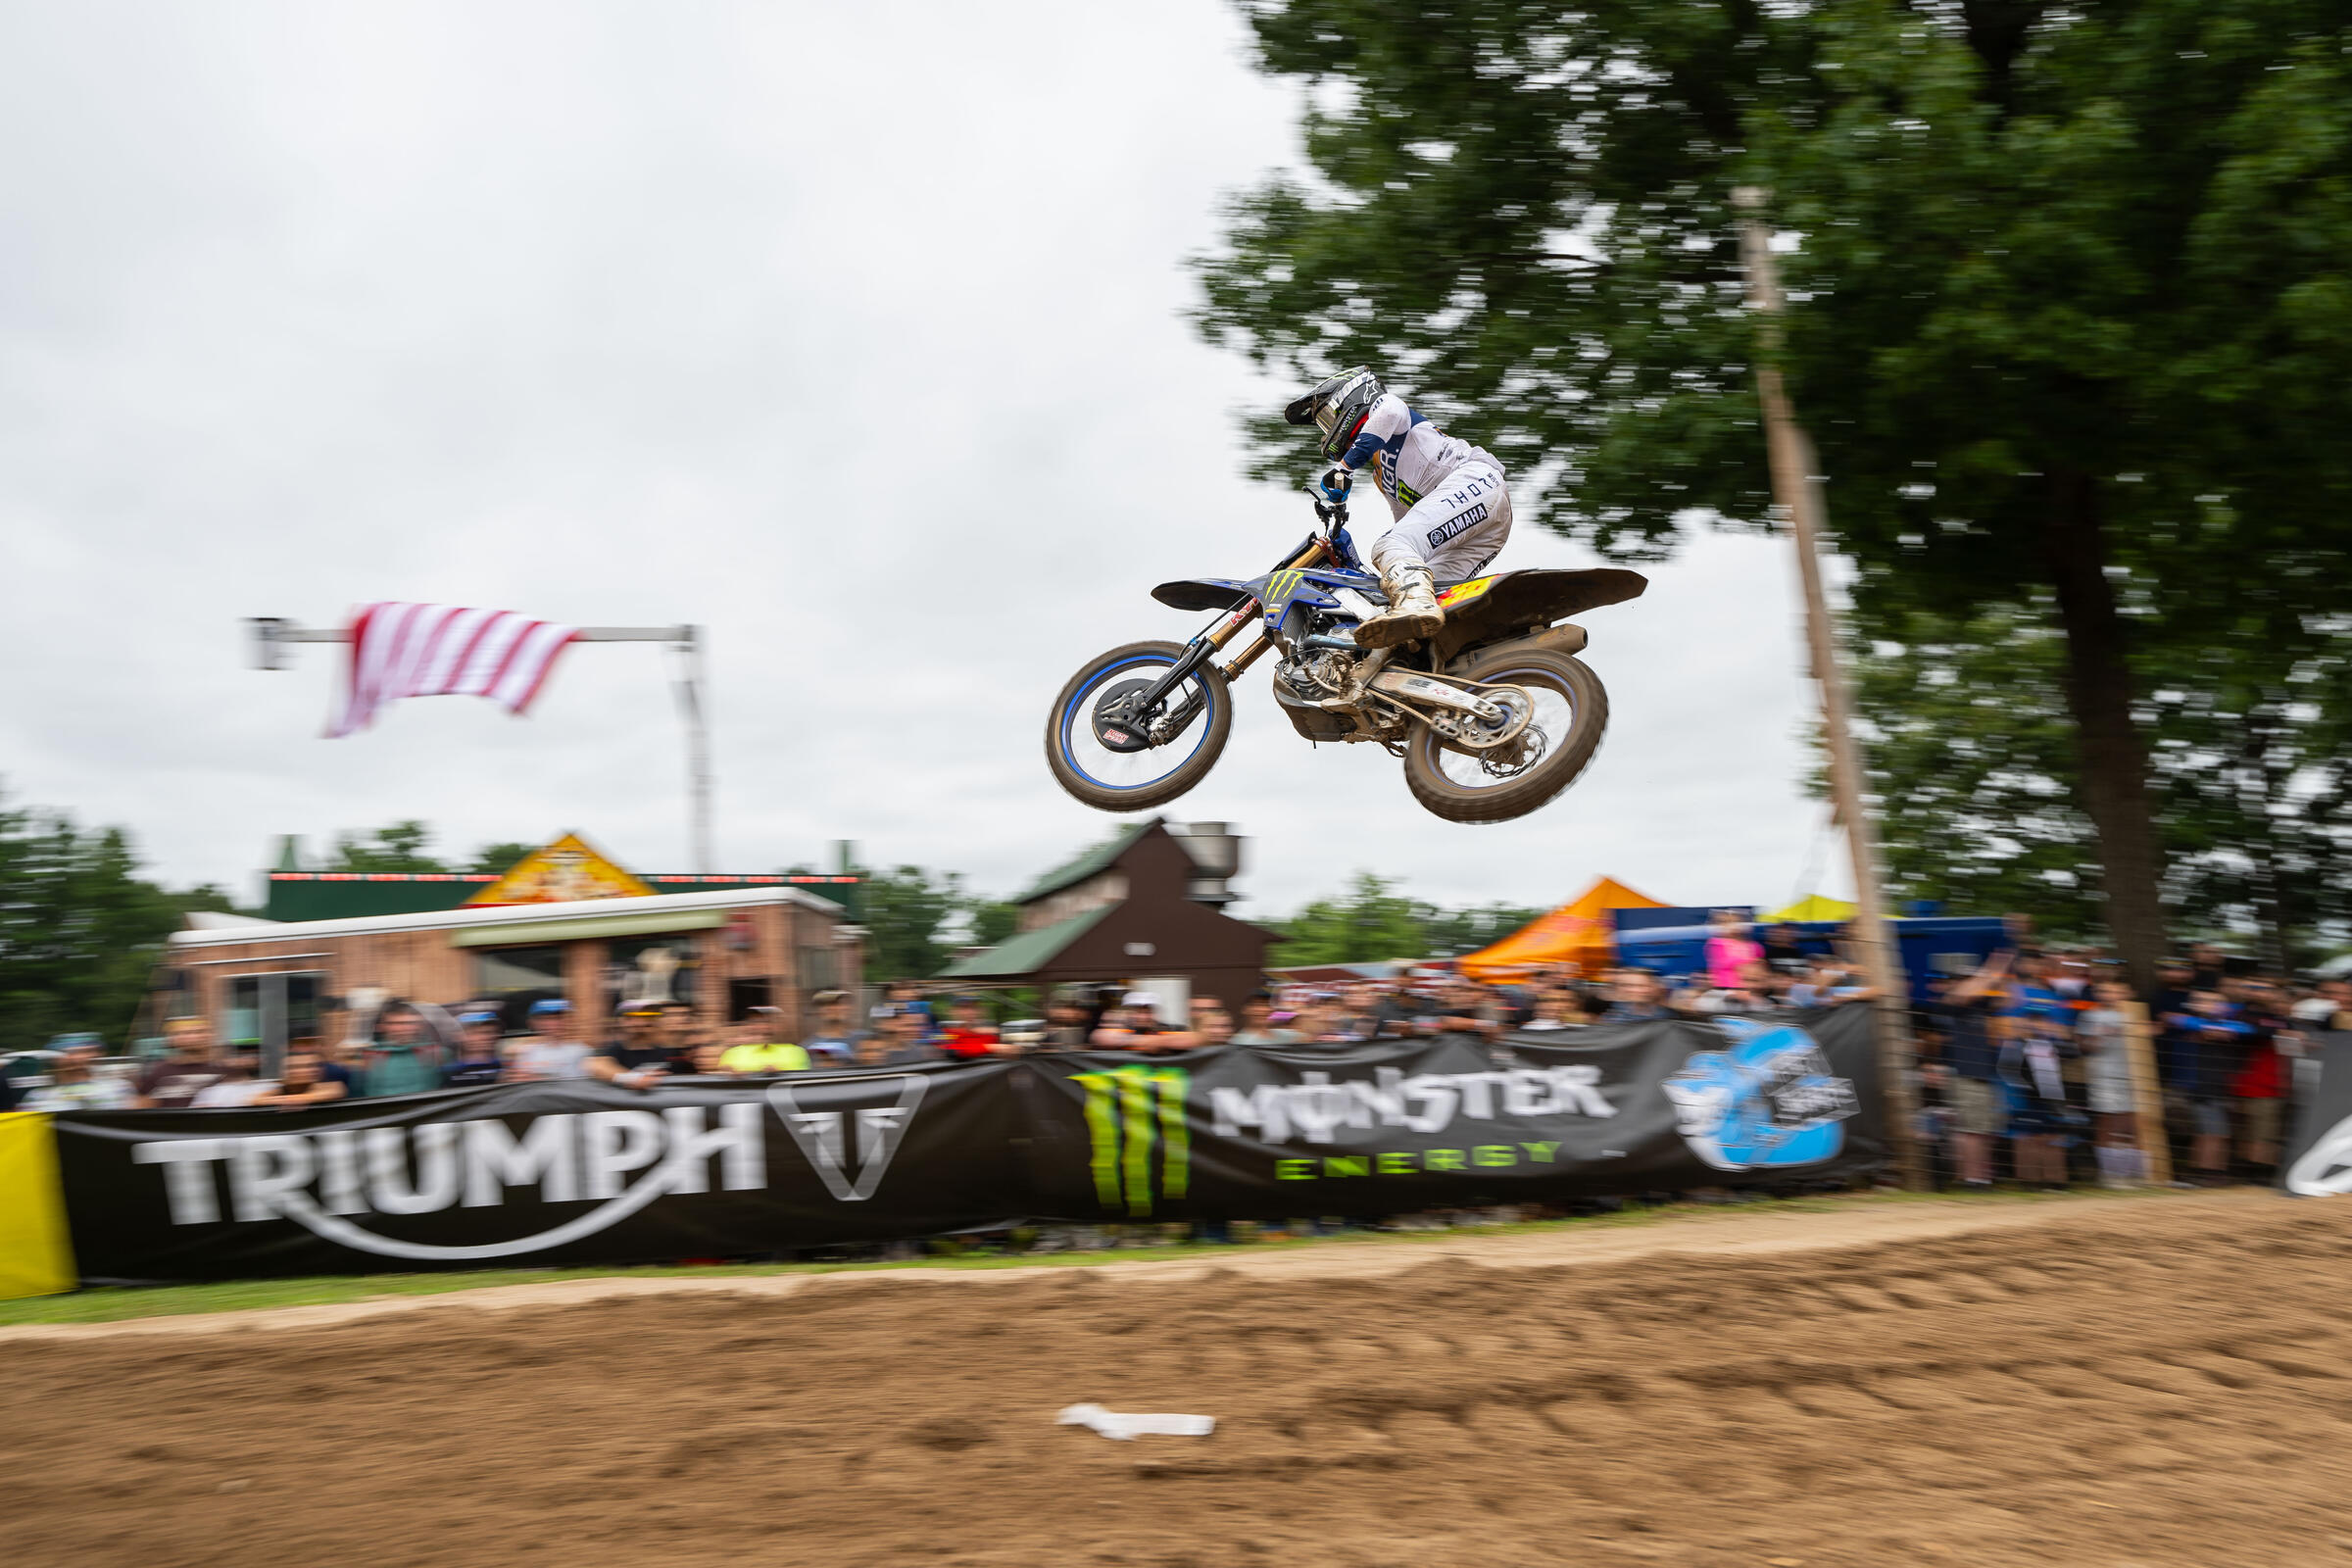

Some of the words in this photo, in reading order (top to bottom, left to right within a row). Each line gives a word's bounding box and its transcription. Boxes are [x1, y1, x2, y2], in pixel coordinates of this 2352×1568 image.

[1441, 505, 1488, 539] YAMAHA
[1209, 1065, 1619, 1145] MONSTER
[131, 1102, 767, 1260] TRIUMPH
[1277, 1141, 1563, 1180] ENERGY
